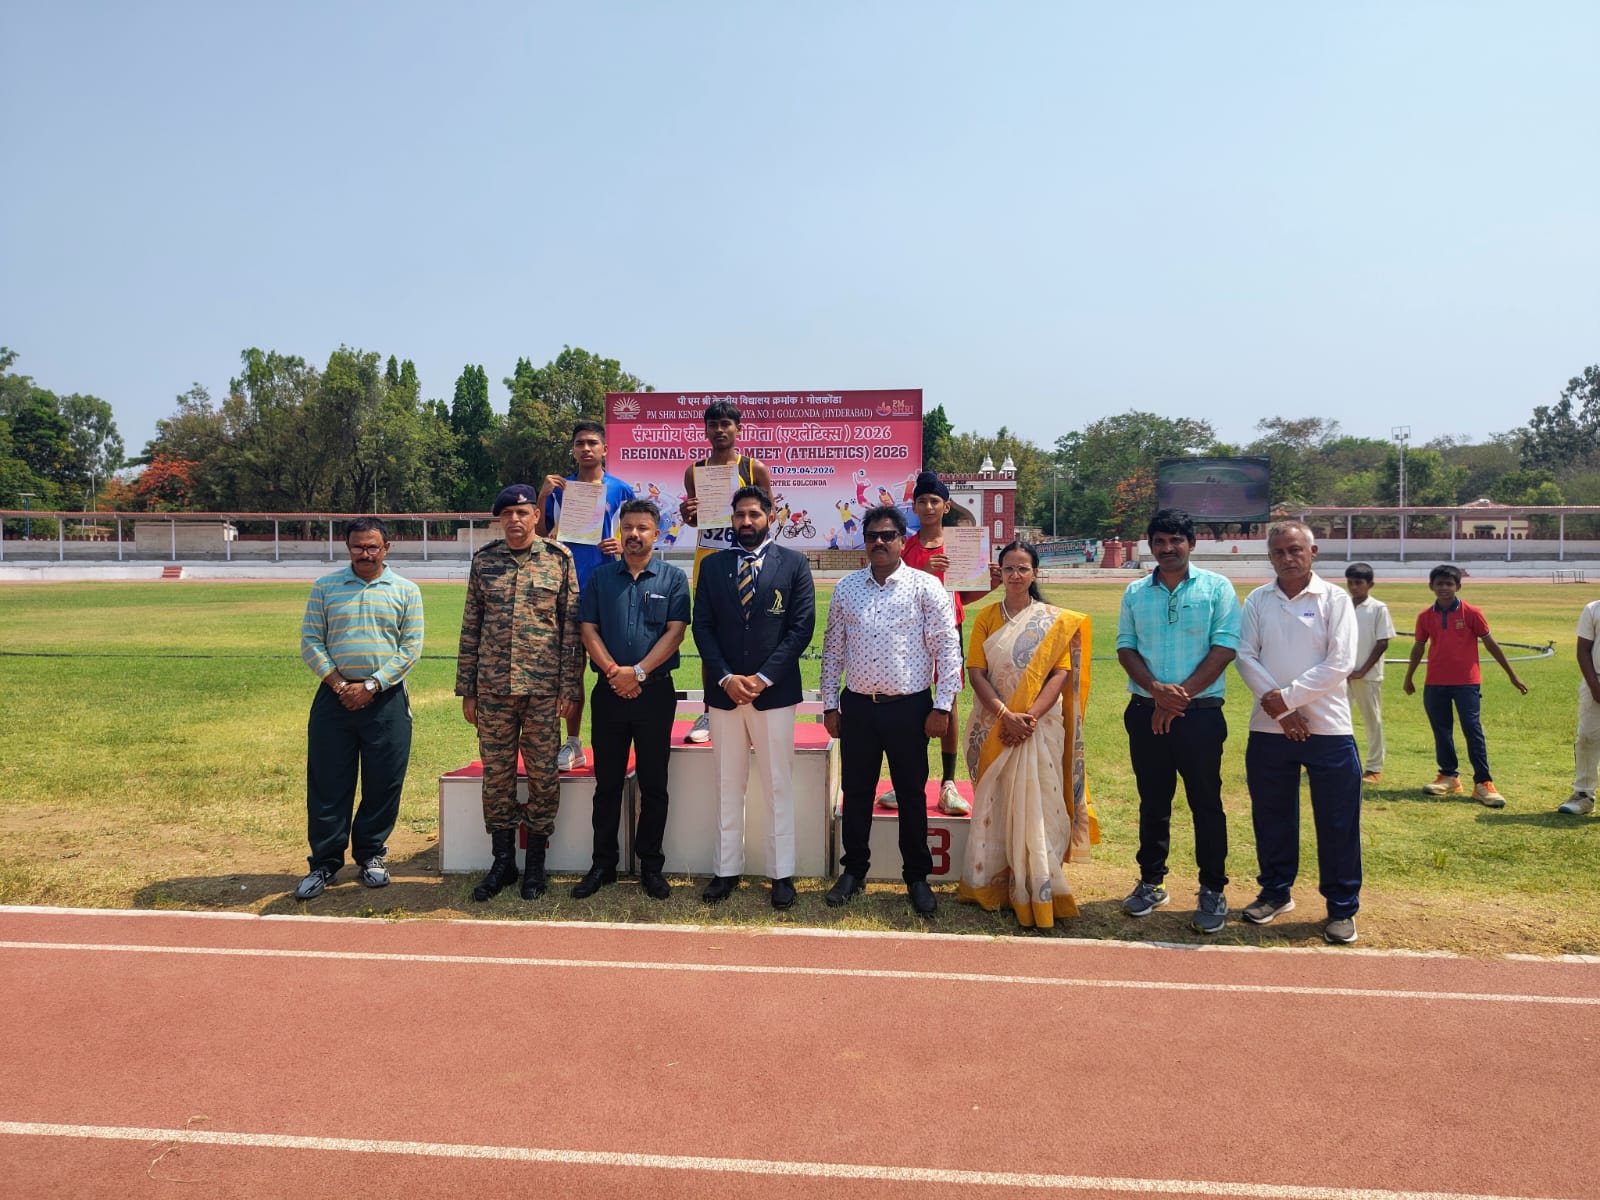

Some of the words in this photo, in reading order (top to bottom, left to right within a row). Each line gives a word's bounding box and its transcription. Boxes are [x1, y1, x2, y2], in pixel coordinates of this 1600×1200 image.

[688, 397, 700, 406] एम
[740, 395, 770, 405] विद्यालय
[646, 410, 657, 420] PM
[659, 410, 676, 420] SHRI
[678, 410, 705, 419] KENDR
[777, 408, 820, 418] GOLCONDA
[822, 407, 873, 419] (HYDERABAD)
[854, 426, 892, 440] 2026
[621, 447, 686, 460] REGIONAL
[744, 447, 782, 459] MEET
[785, 446, 870, 461] (ATHLETICS)
[873, 446, 908, 459] 2026
[772, 466, 784, 474] TO
[786, 466, 834, 474] 29.04.2026
[792, 479, 827, 487] GOLCONDA
[927, 827, 951, 875] 3
